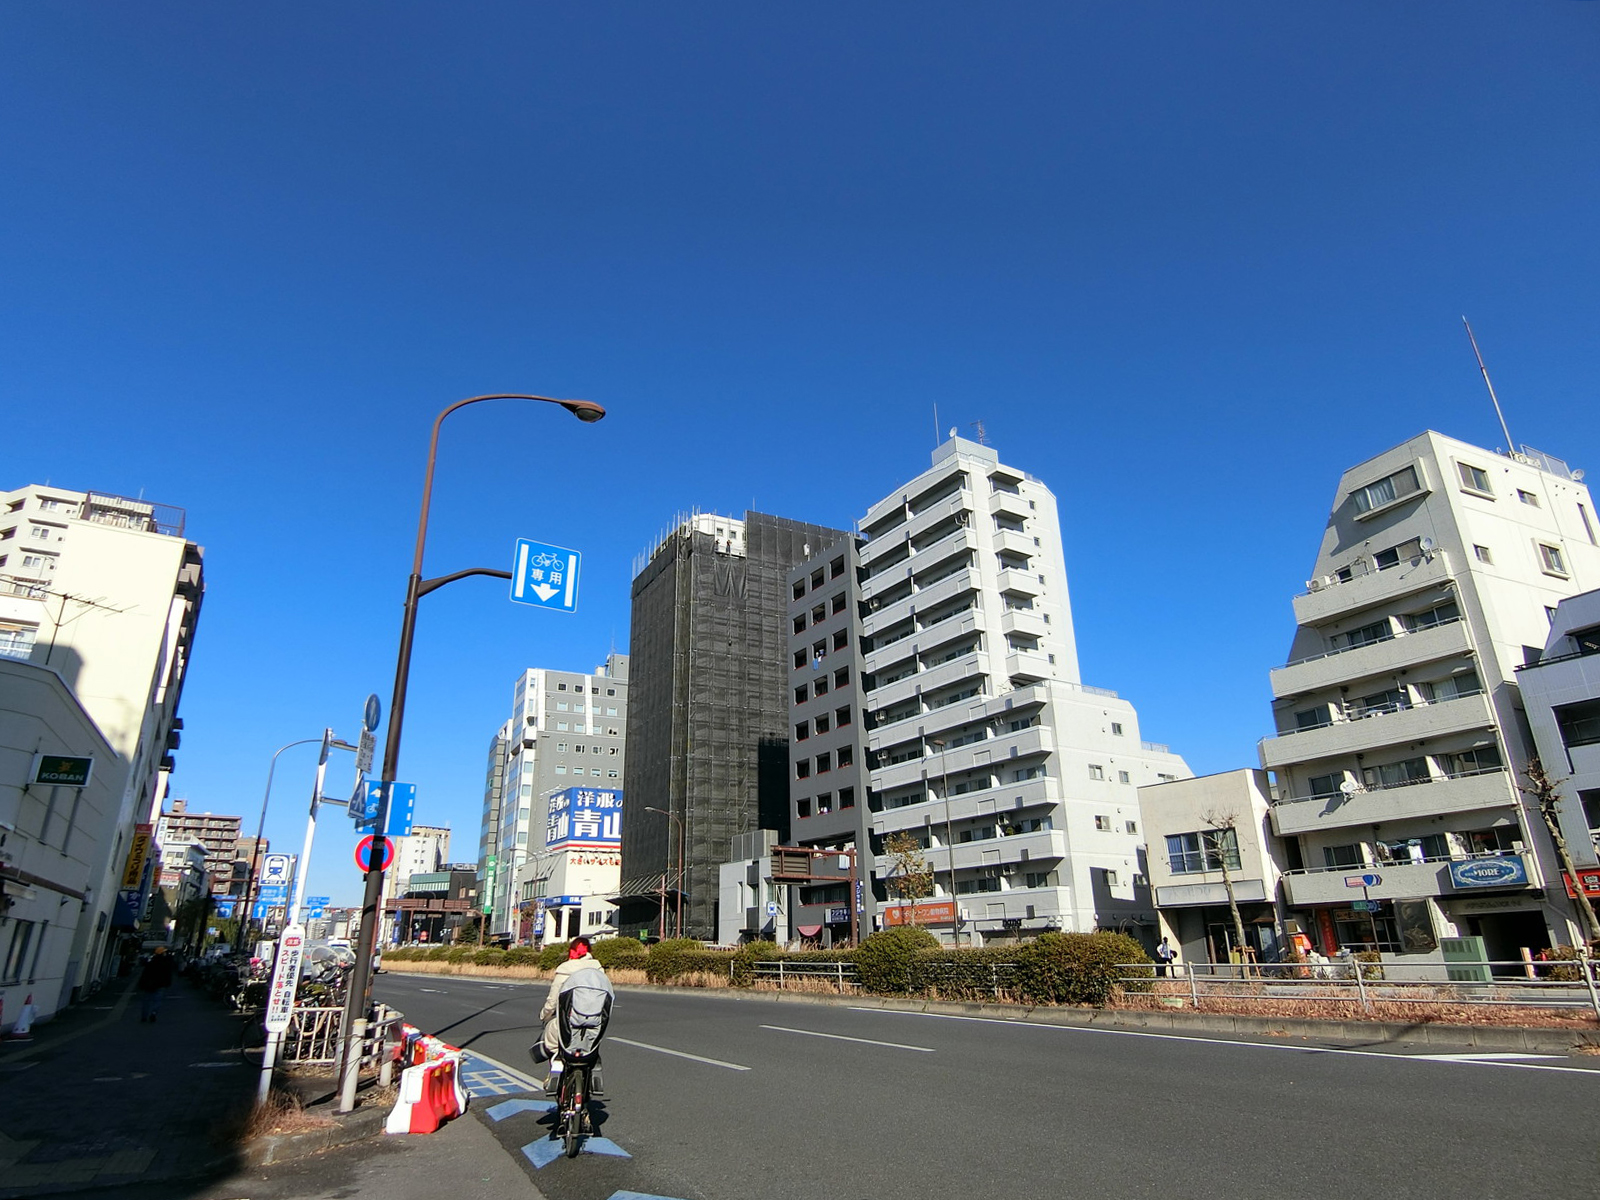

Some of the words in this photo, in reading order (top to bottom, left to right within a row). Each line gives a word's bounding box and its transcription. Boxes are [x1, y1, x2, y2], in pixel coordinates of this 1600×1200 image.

[530, 568, 562, 585] 専用
[41, 772, 84, 781] KOBAN
[547, 811, 570, 843] 青山
[572, 809, 622, 838] 青山
[1473, 868, 1501, 877] MORE
[285, 949, 298, 987] 歩行者優先
